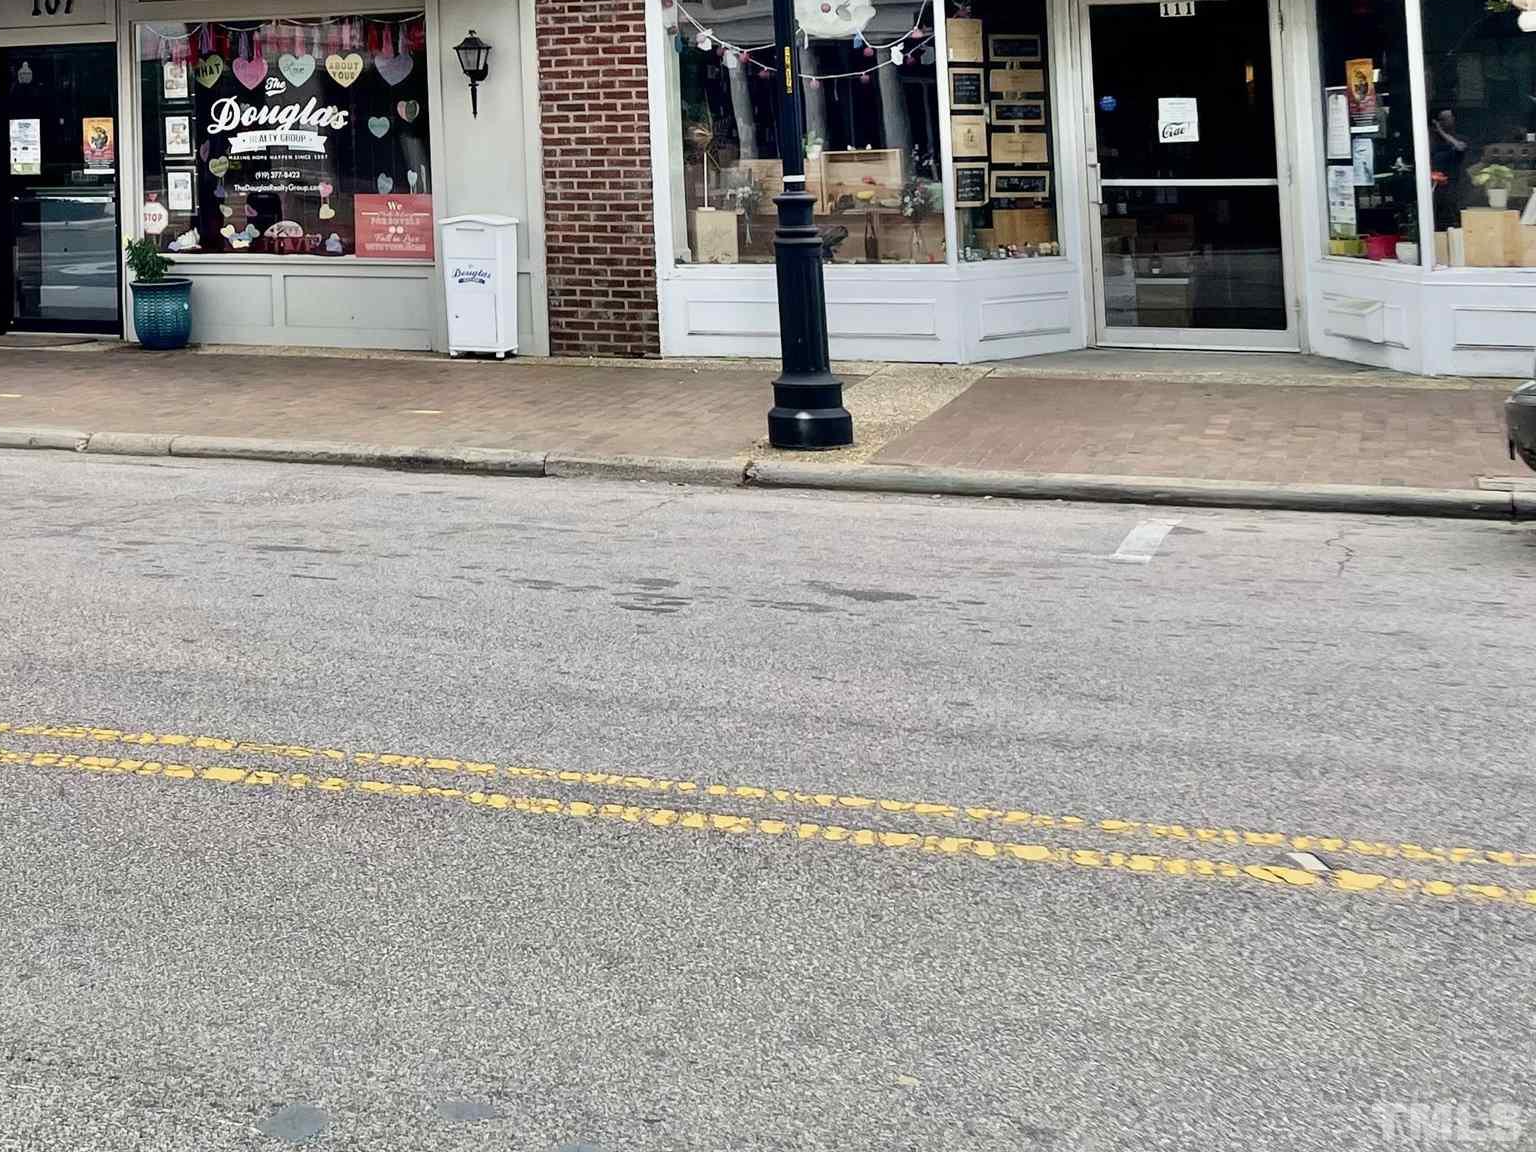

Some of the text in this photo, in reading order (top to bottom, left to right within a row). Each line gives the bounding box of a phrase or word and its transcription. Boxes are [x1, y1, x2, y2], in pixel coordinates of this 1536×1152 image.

[1163, 3, 1193, 16] 111
[265, 77, 288, 95] The
[208, 96, 348, 134] Douglas
[270, 171, 301, 179] 377-8423
